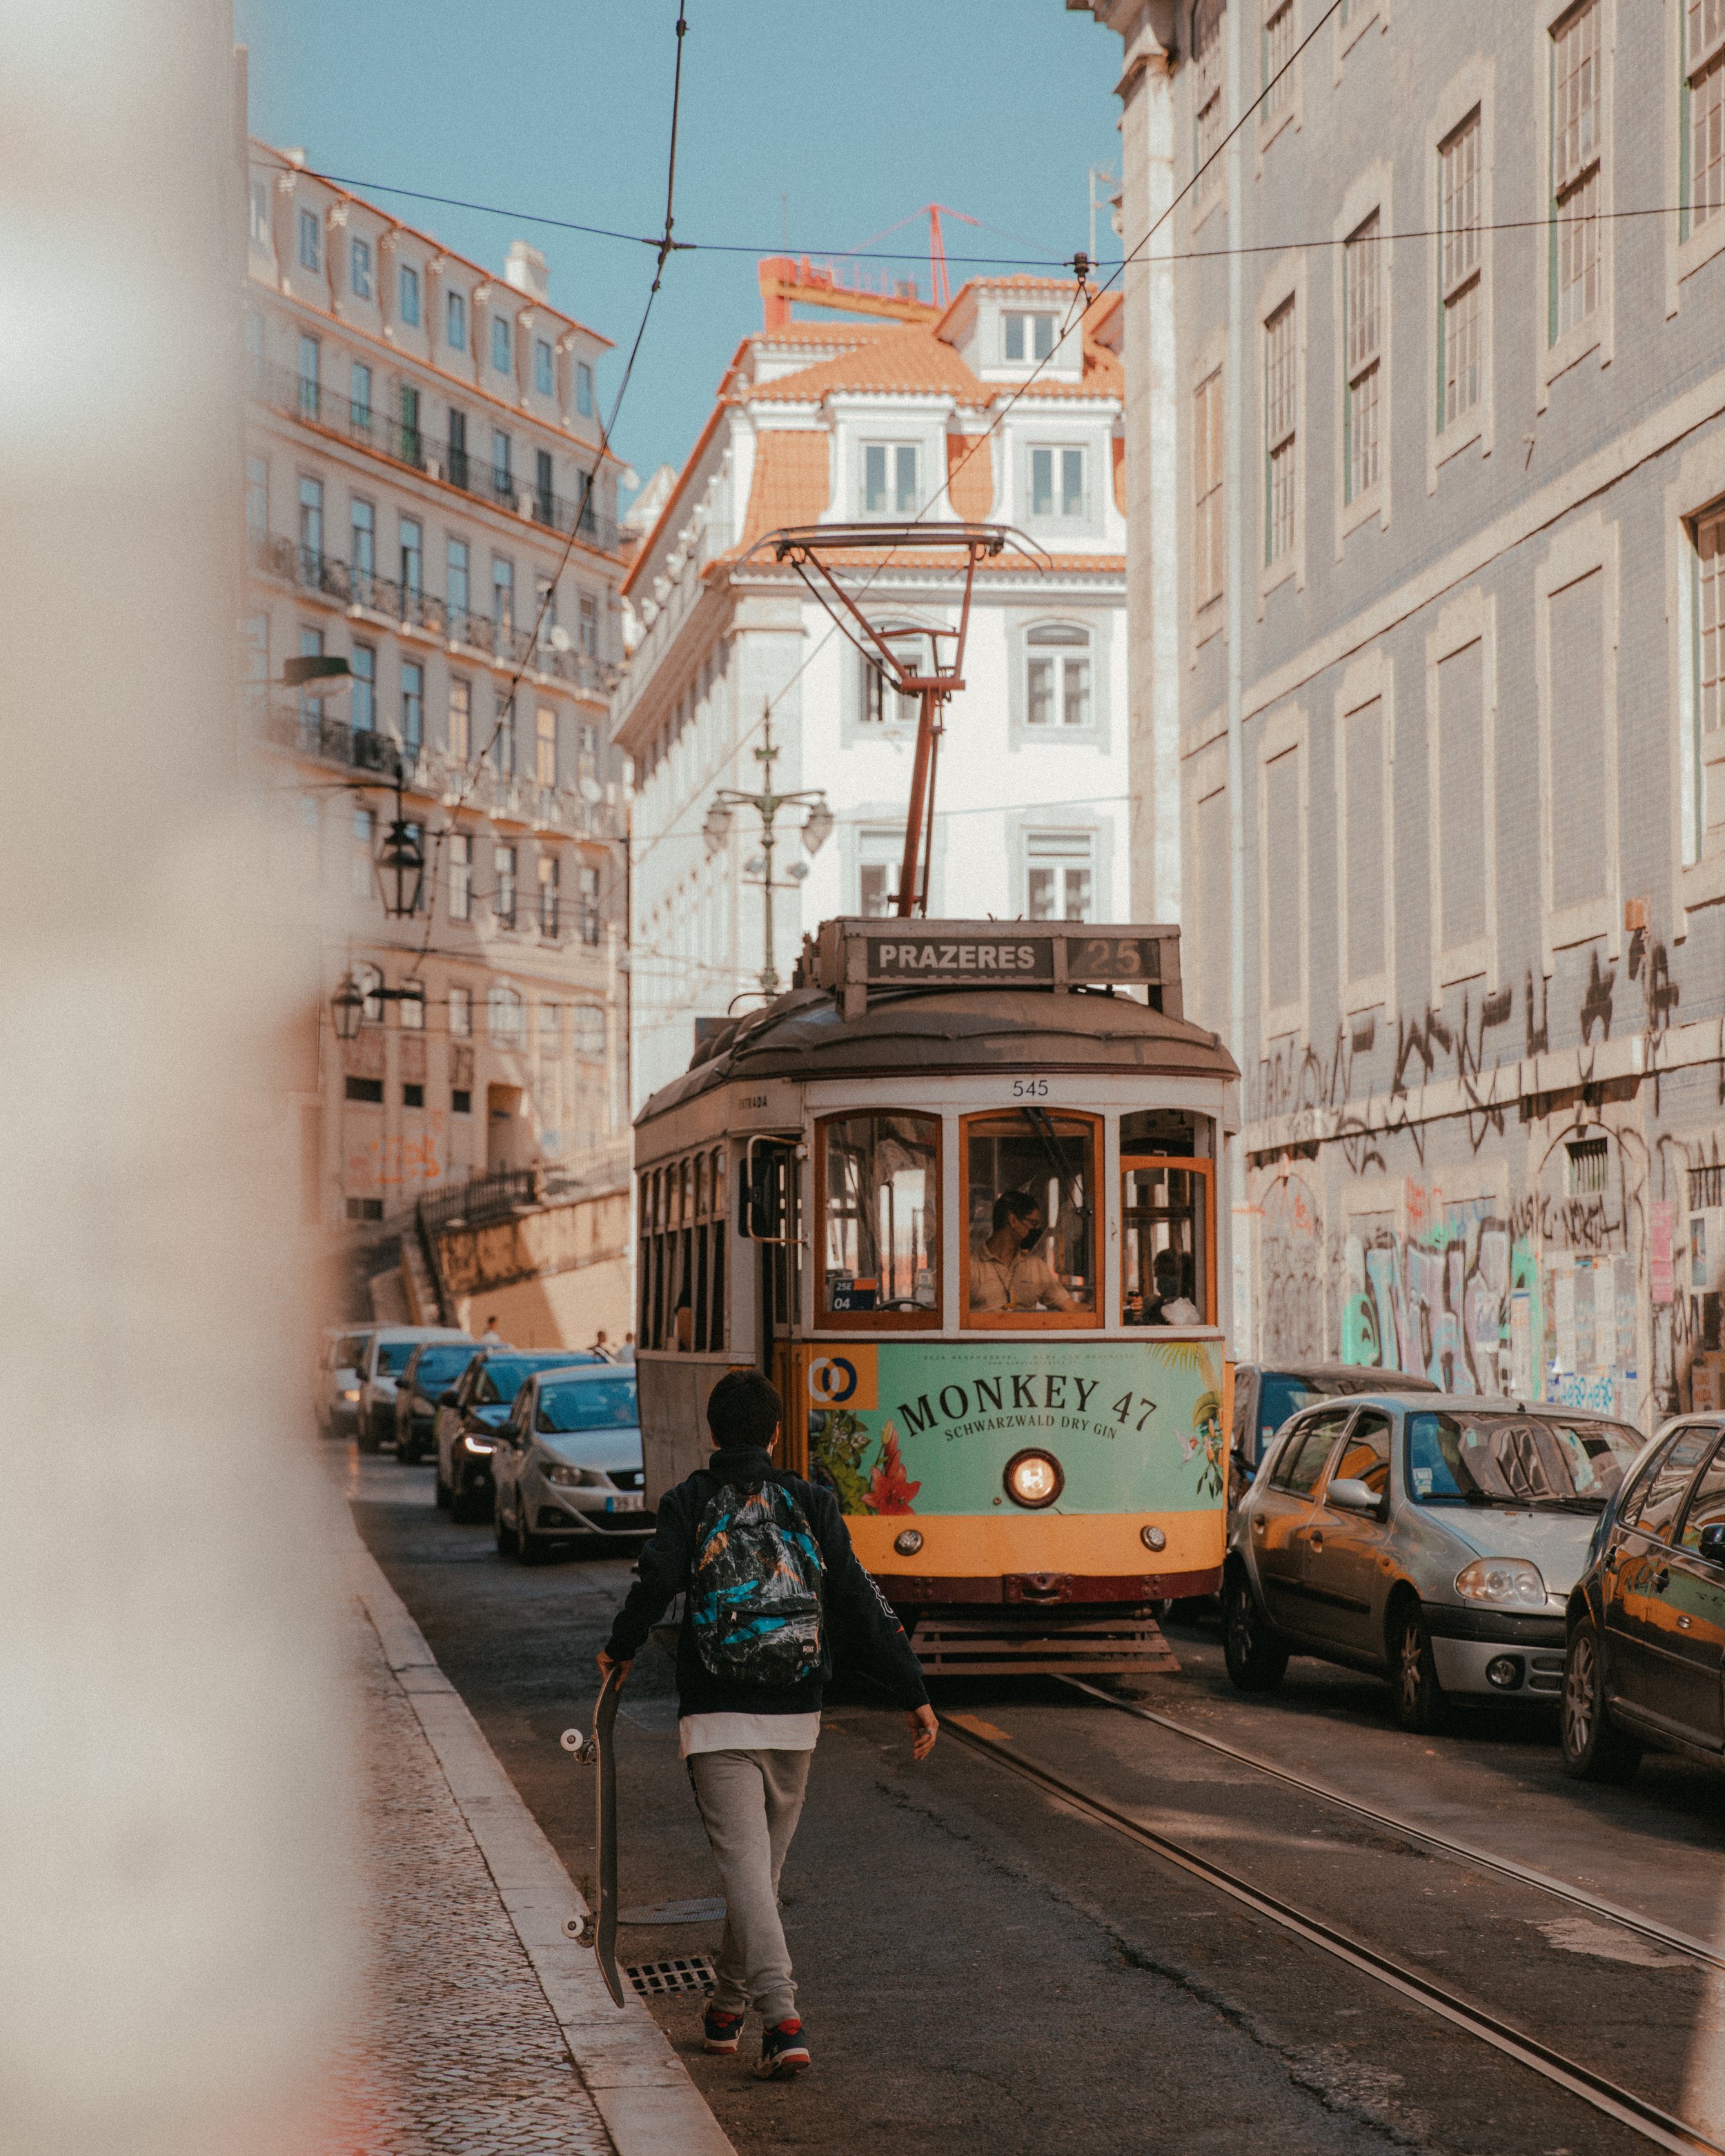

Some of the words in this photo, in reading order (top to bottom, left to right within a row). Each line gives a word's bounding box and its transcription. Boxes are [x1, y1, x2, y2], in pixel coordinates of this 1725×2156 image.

[879, 945, 1035, 969] PRAZERES
[1088, 940, 1141, 973] 25
[1013, 1080, 1048, 1097] 545
[836, 1282, 853, 1291] 25E
[834, 1298, 850, 1309] 04
[897, 1374, 1100, 1437] MONKEY
[1112, 1392, 1156, 1432] 47
[945, 1415, 1054, 1441] SCHWARZWALD
[1061, 1416, 1090, 1431] DRY
[1094, 1423, 1117, 1439] GIN
